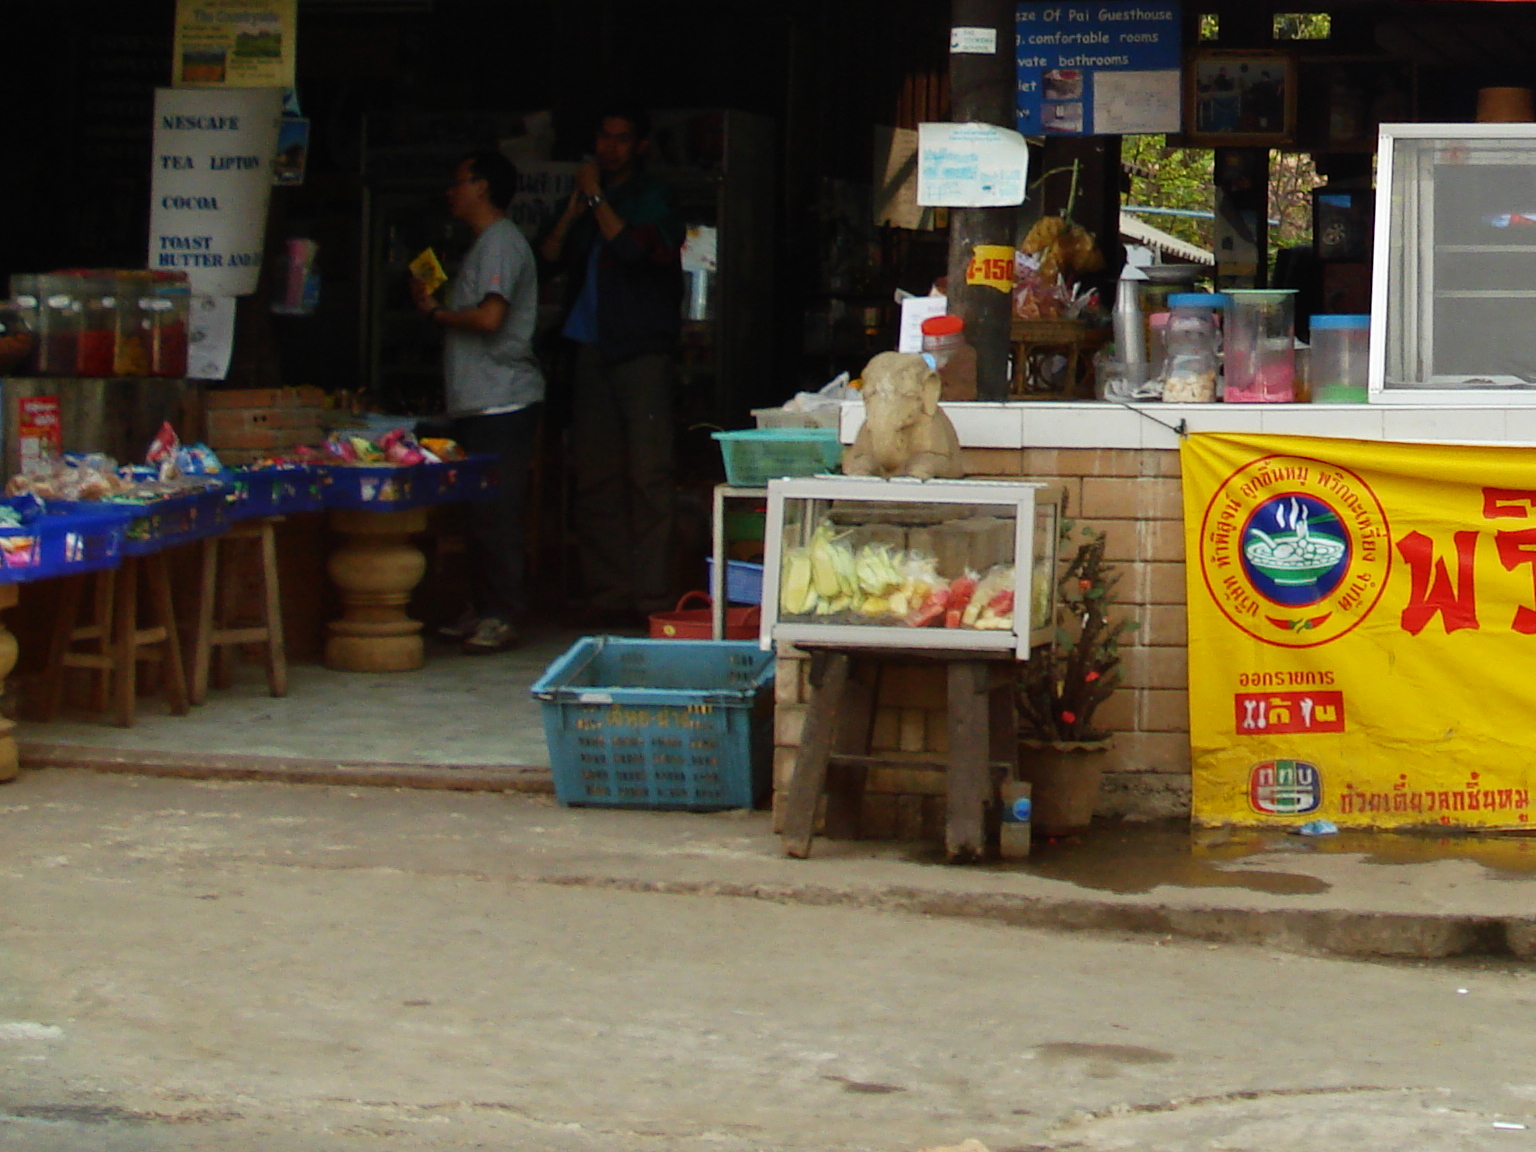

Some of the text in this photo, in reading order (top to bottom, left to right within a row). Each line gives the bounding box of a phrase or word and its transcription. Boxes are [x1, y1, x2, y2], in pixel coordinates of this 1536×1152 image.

[1043, 9, 1062, 22] Of
[1068, 9, 1090, 22] Pai
[1098, 8, 1173, 22] Guesthouse
[1028, 32, 1110, 45] comfortable
[1119, 32, 1159, 43] rooms
[1058, 54, 1129, 67] bathrooms
[162, 115, 240, 130] NESCAFE
[160, 155, 260, 171] TEA LIPTON
[161, 196, 219, 210] COCOA
[158, 236, 214, 250] TOAST
[158, 252, 224, 267] BUTTER
[1239, 670, 1336, 687] ออกรายการ
